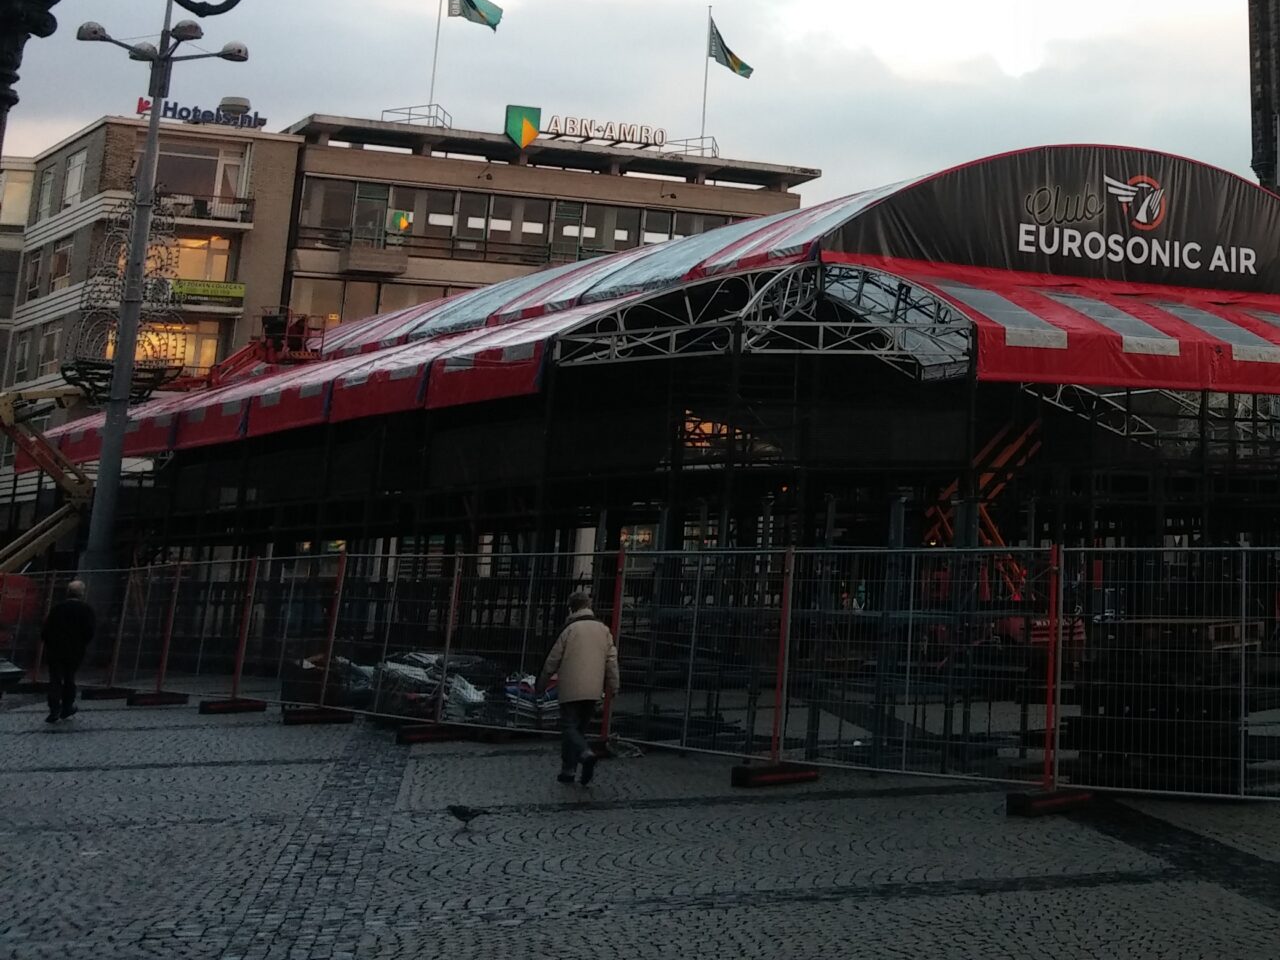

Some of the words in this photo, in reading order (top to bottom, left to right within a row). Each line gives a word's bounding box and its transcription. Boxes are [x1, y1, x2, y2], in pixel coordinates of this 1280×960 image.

[1024, 183, 1105, 227] Club
[1017, 222, 1202, 270] EUROSONIC
[1208, 245, 1258, 276] AIR
